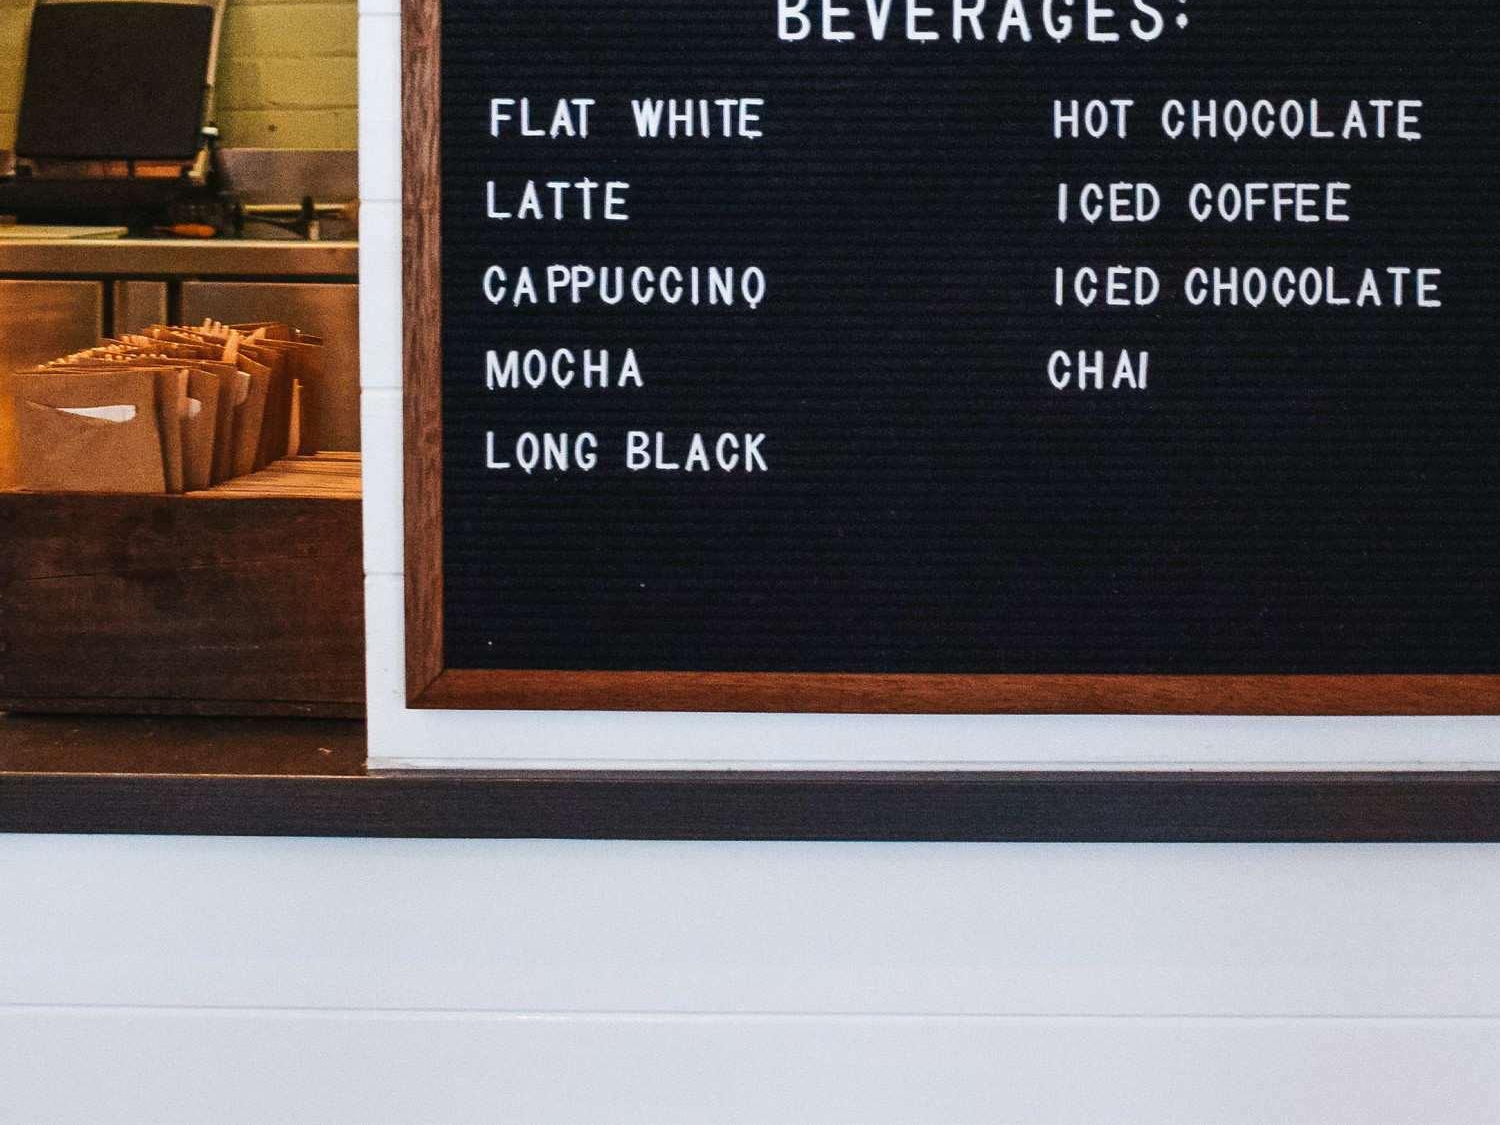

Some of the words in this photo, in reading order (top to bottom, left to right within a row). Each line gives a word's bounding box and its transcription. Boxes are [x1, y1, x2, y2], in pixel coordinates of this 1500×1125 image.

[491, 98, 595, 139] FLAT
[631, 98, 764, 139] WHITE
[1054, 100, 1134, 138] HOT
[1162, 98, 1422, 142] CHOCOLATE
[487, 177, 629, 220] LATTE
[1058, 181, 1160, 223] ICED
[1189, 182, 1351, 222] COFFEE
[483, 264, 765, 309] CAPPUCCINO
[1056, 265, 1159, 306] ICED
[1185, 266, 1441, 307] CHOCOLATE
[486, 348, 643, 390] MOCHA
[1048, 349, 1148, 390] CHAI
[487, 431, 597, 474] LONG
[627, 431, 768, 472] BLACK
